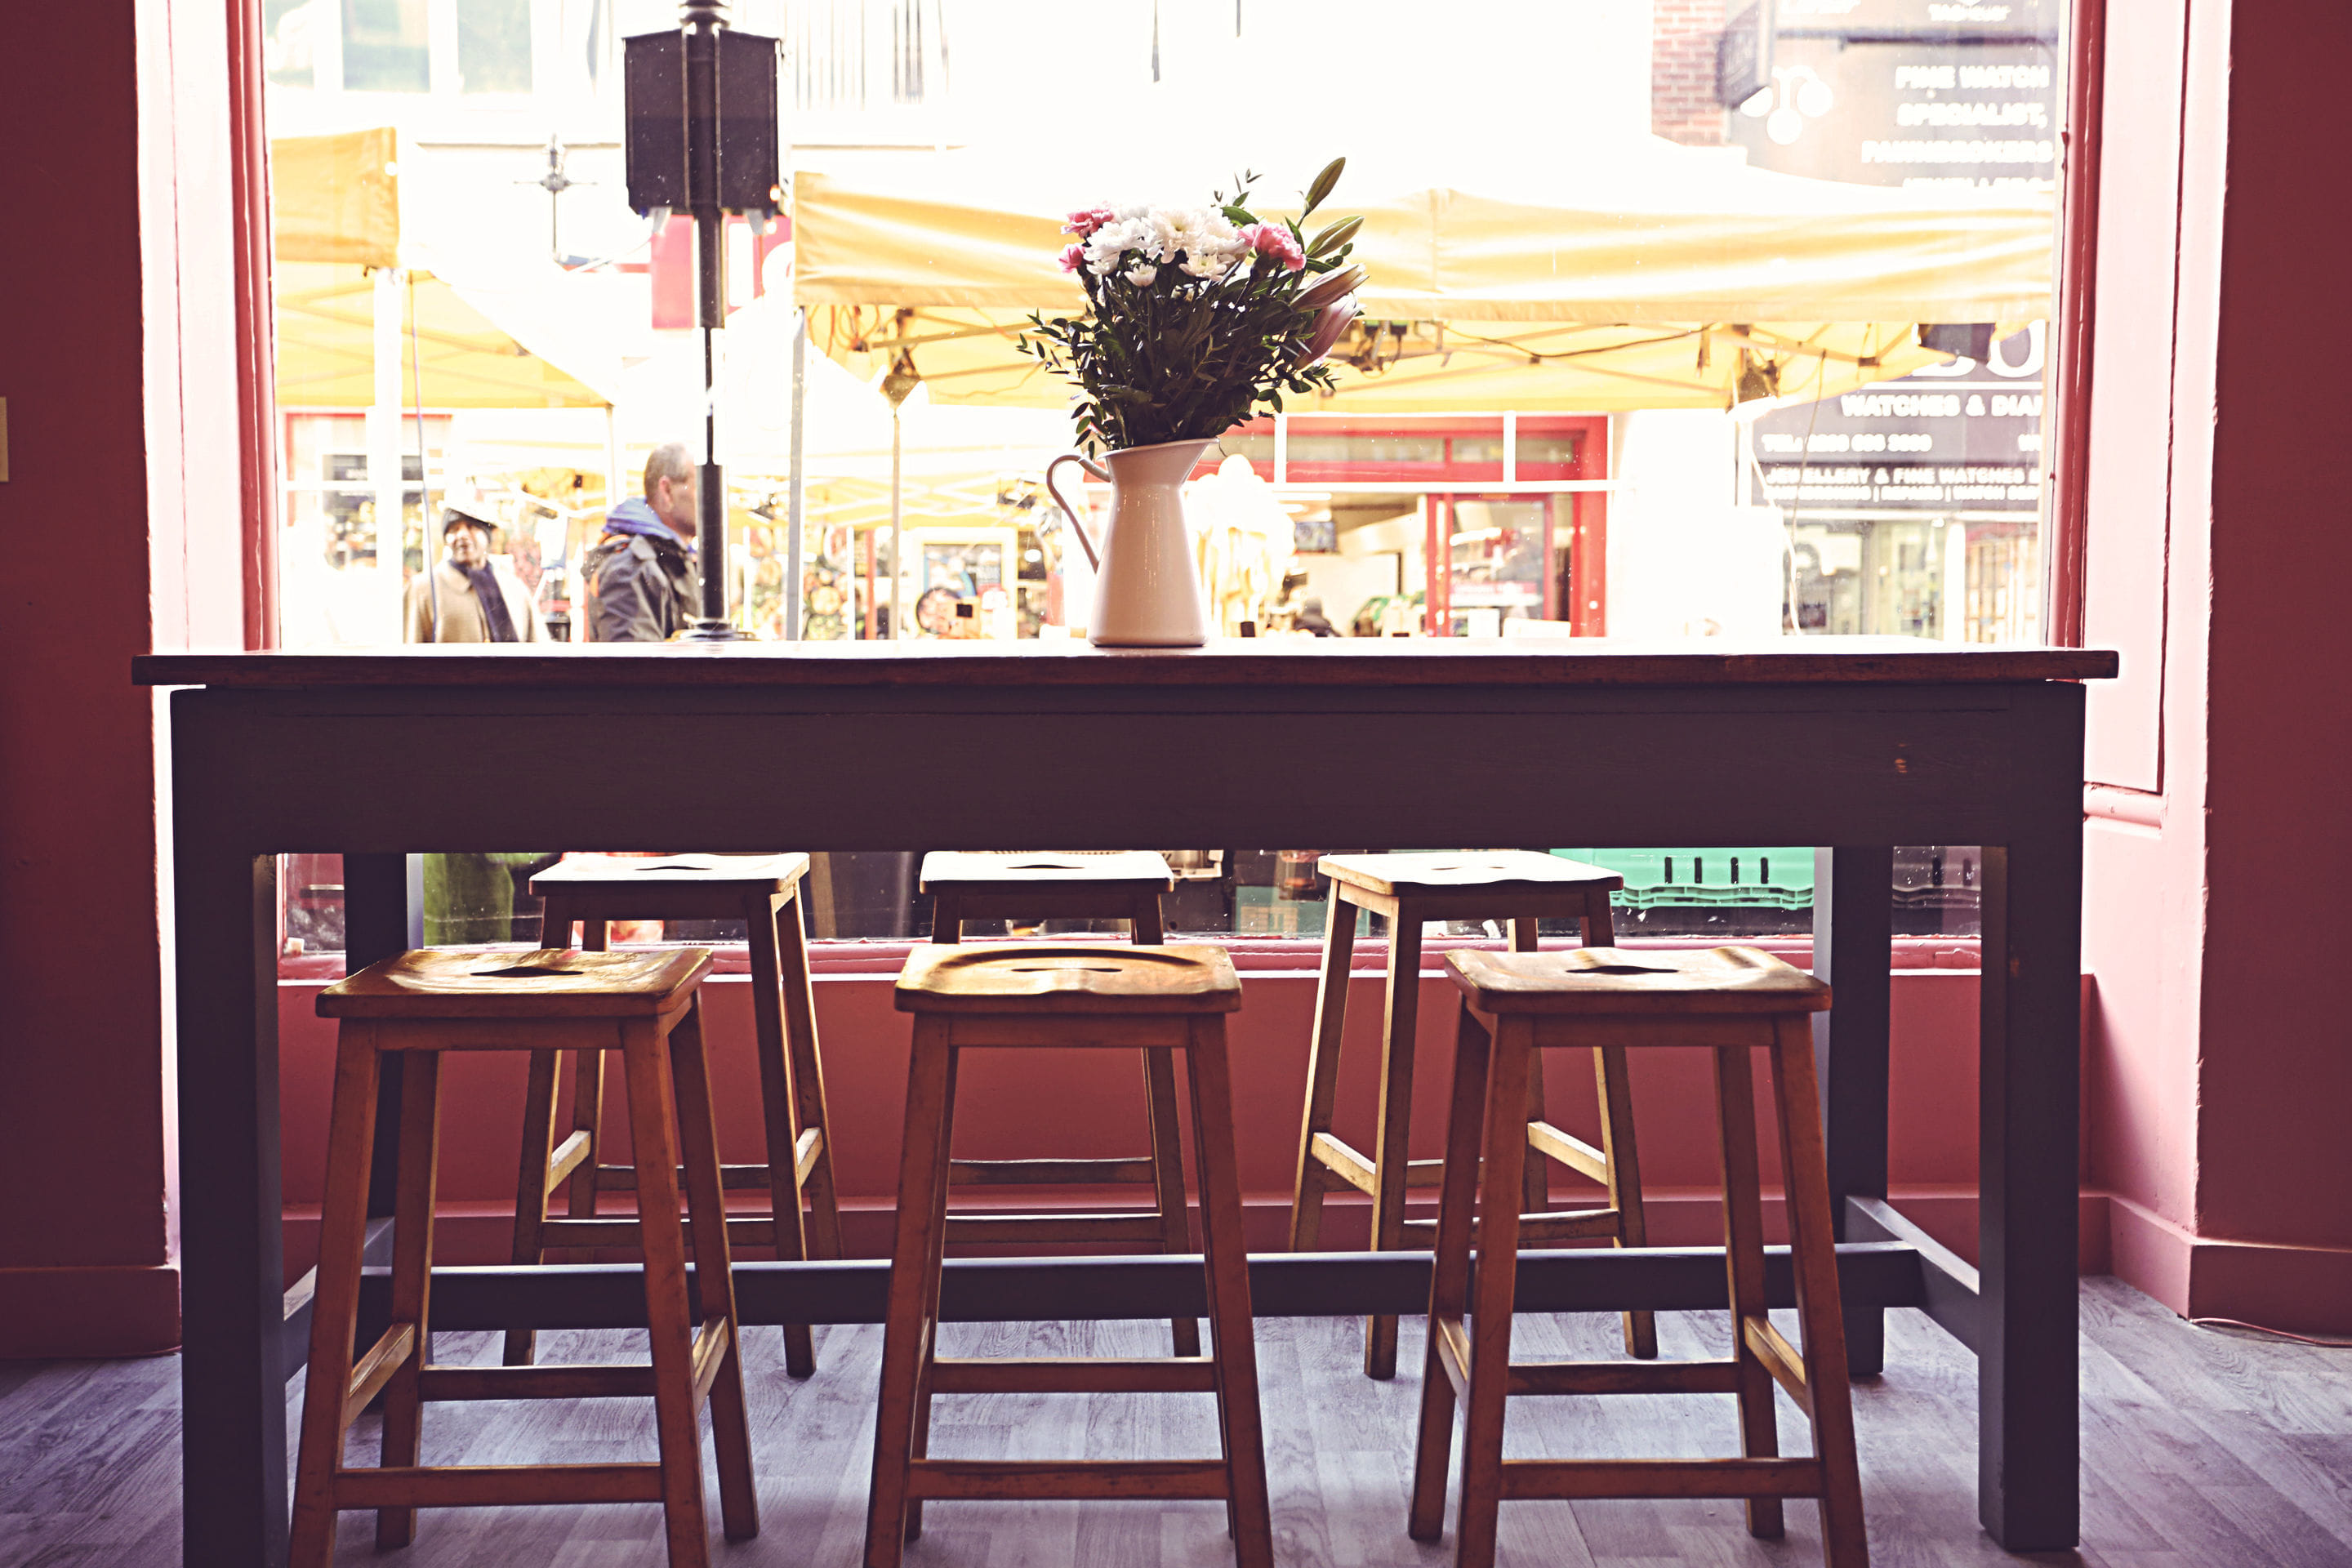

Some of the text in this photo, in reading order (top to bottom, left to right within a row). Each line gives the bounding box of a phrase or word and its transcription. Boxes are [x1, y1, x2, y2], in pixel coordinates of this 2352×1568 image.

[1959, 65, 2050, 89] WATCH
[1841, 394, 1960, 416] WATCHES
[1966, 394, 1986, 416] &
[1874, 467, 1890, 484] &
[1939, 467, 2025, 484] WATCHES
